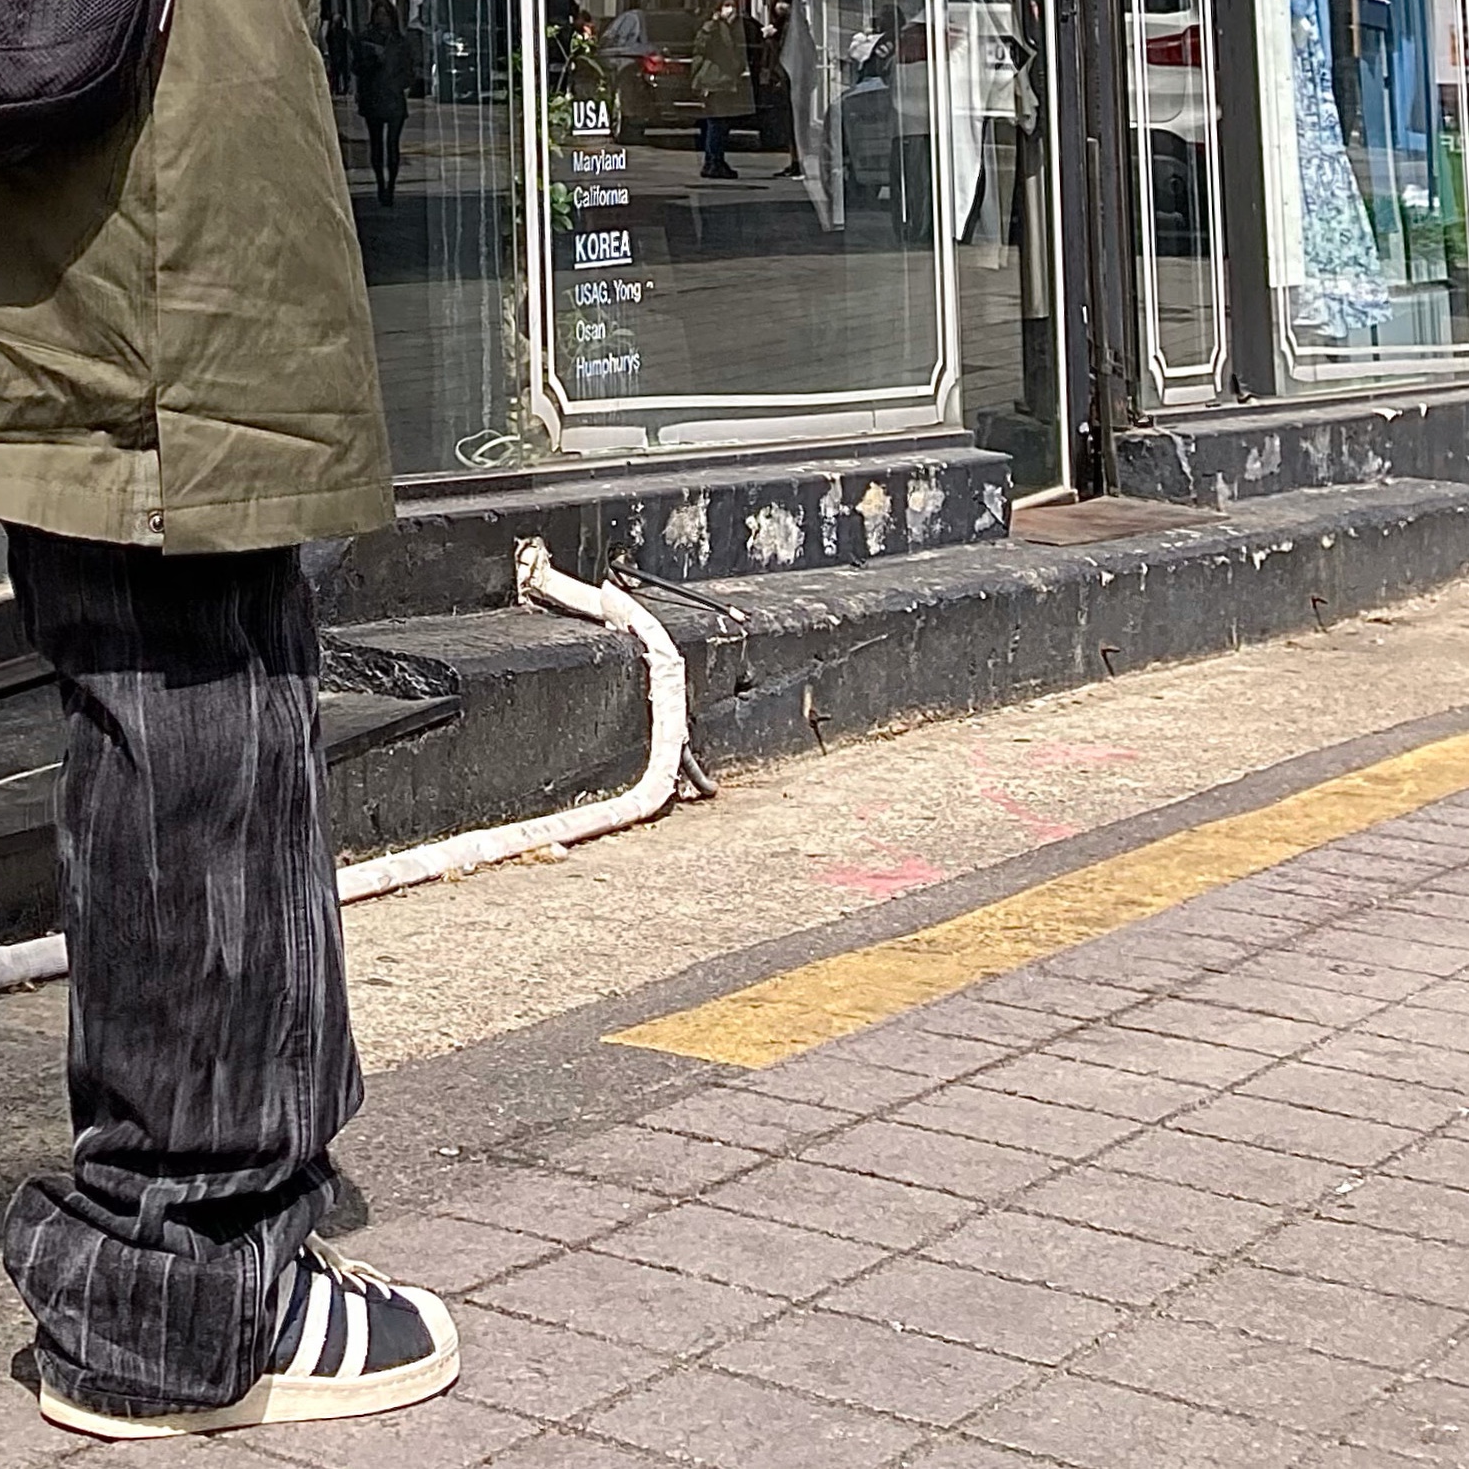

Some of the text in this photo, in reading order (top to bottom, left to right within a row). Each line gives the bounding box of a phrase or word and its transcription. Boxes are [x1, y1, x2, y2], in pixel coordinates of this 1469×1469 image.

[573, 100, 610, 128] USA
[573, 148, 627, 175] Maryland
[573, 184, 629, 210] California
[575, 230, 632, 262] KOREA
[613, 279, 642, 303] Yong
[576, 320, 606, 341] Osan
